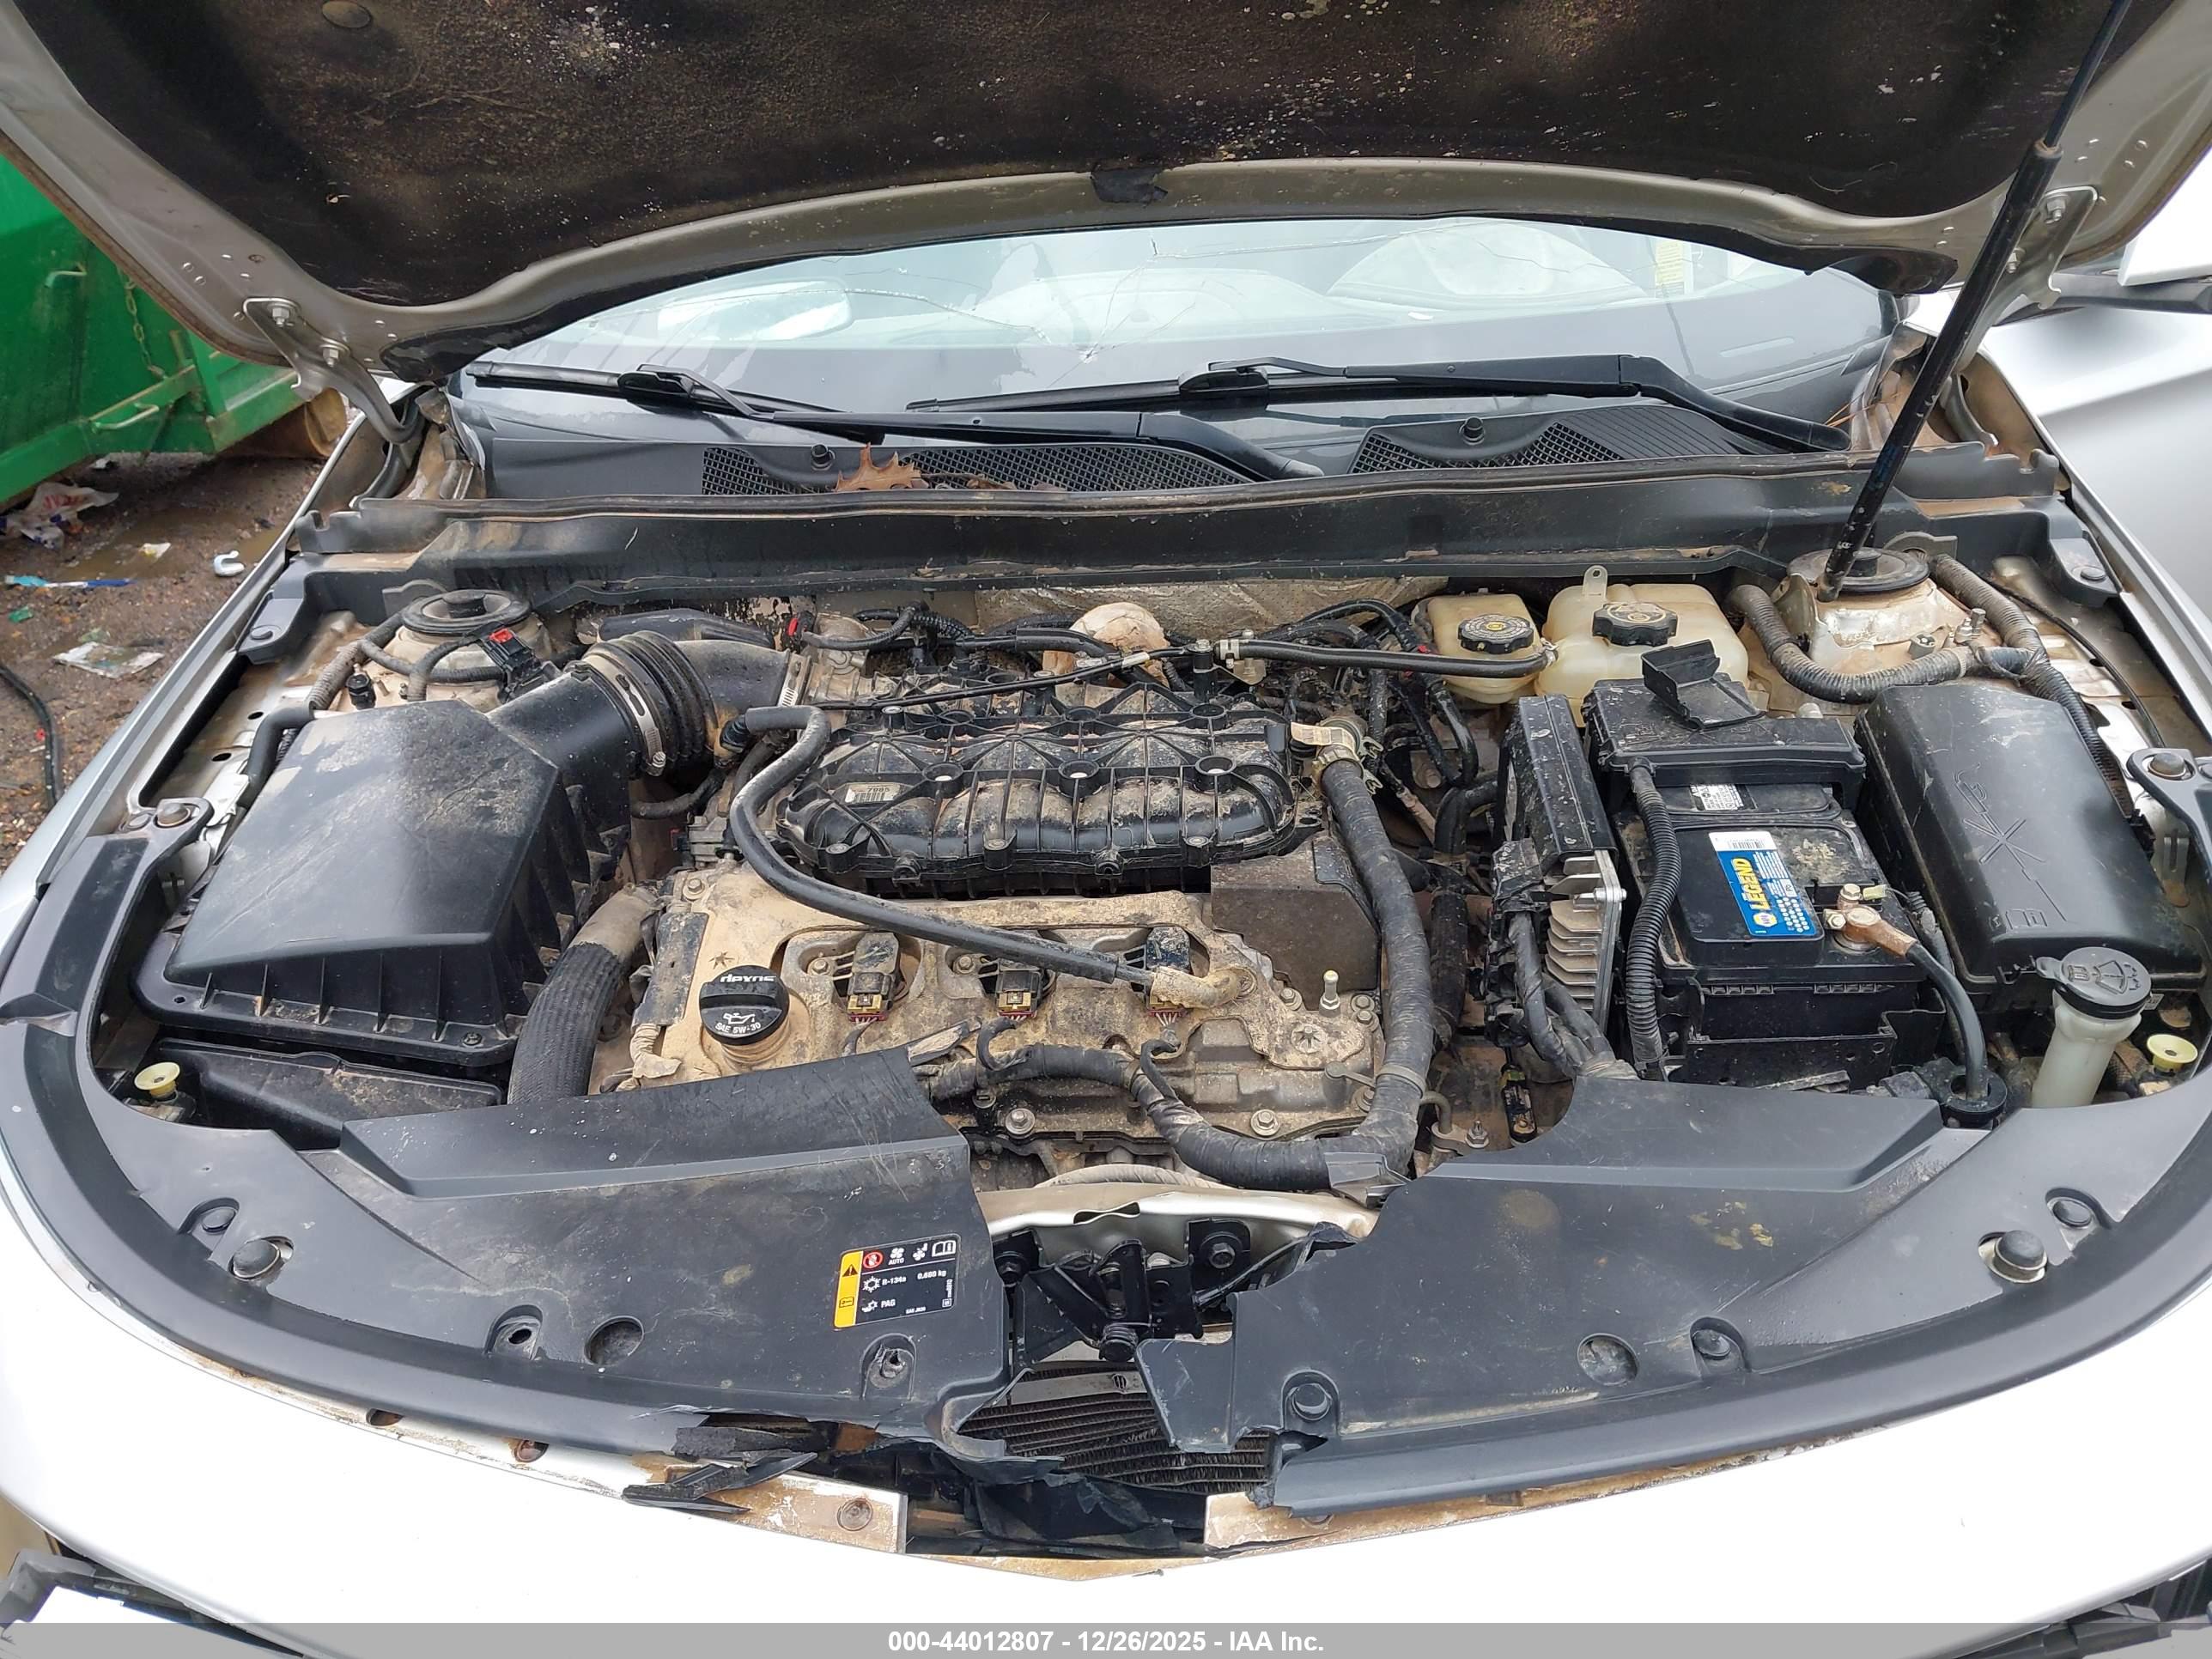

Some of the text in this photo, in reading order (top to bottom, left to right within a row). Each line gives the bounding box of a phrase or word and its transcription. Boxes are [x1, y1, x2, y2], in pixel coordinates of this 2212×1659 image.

[1731, 858, 1771, 910] LEGEND
[715, 1022, 762, 1034] SAE 5W-30
[882, 1276, 907, 1285] R-134a
[881, 1299, 896, 1308] PAG
